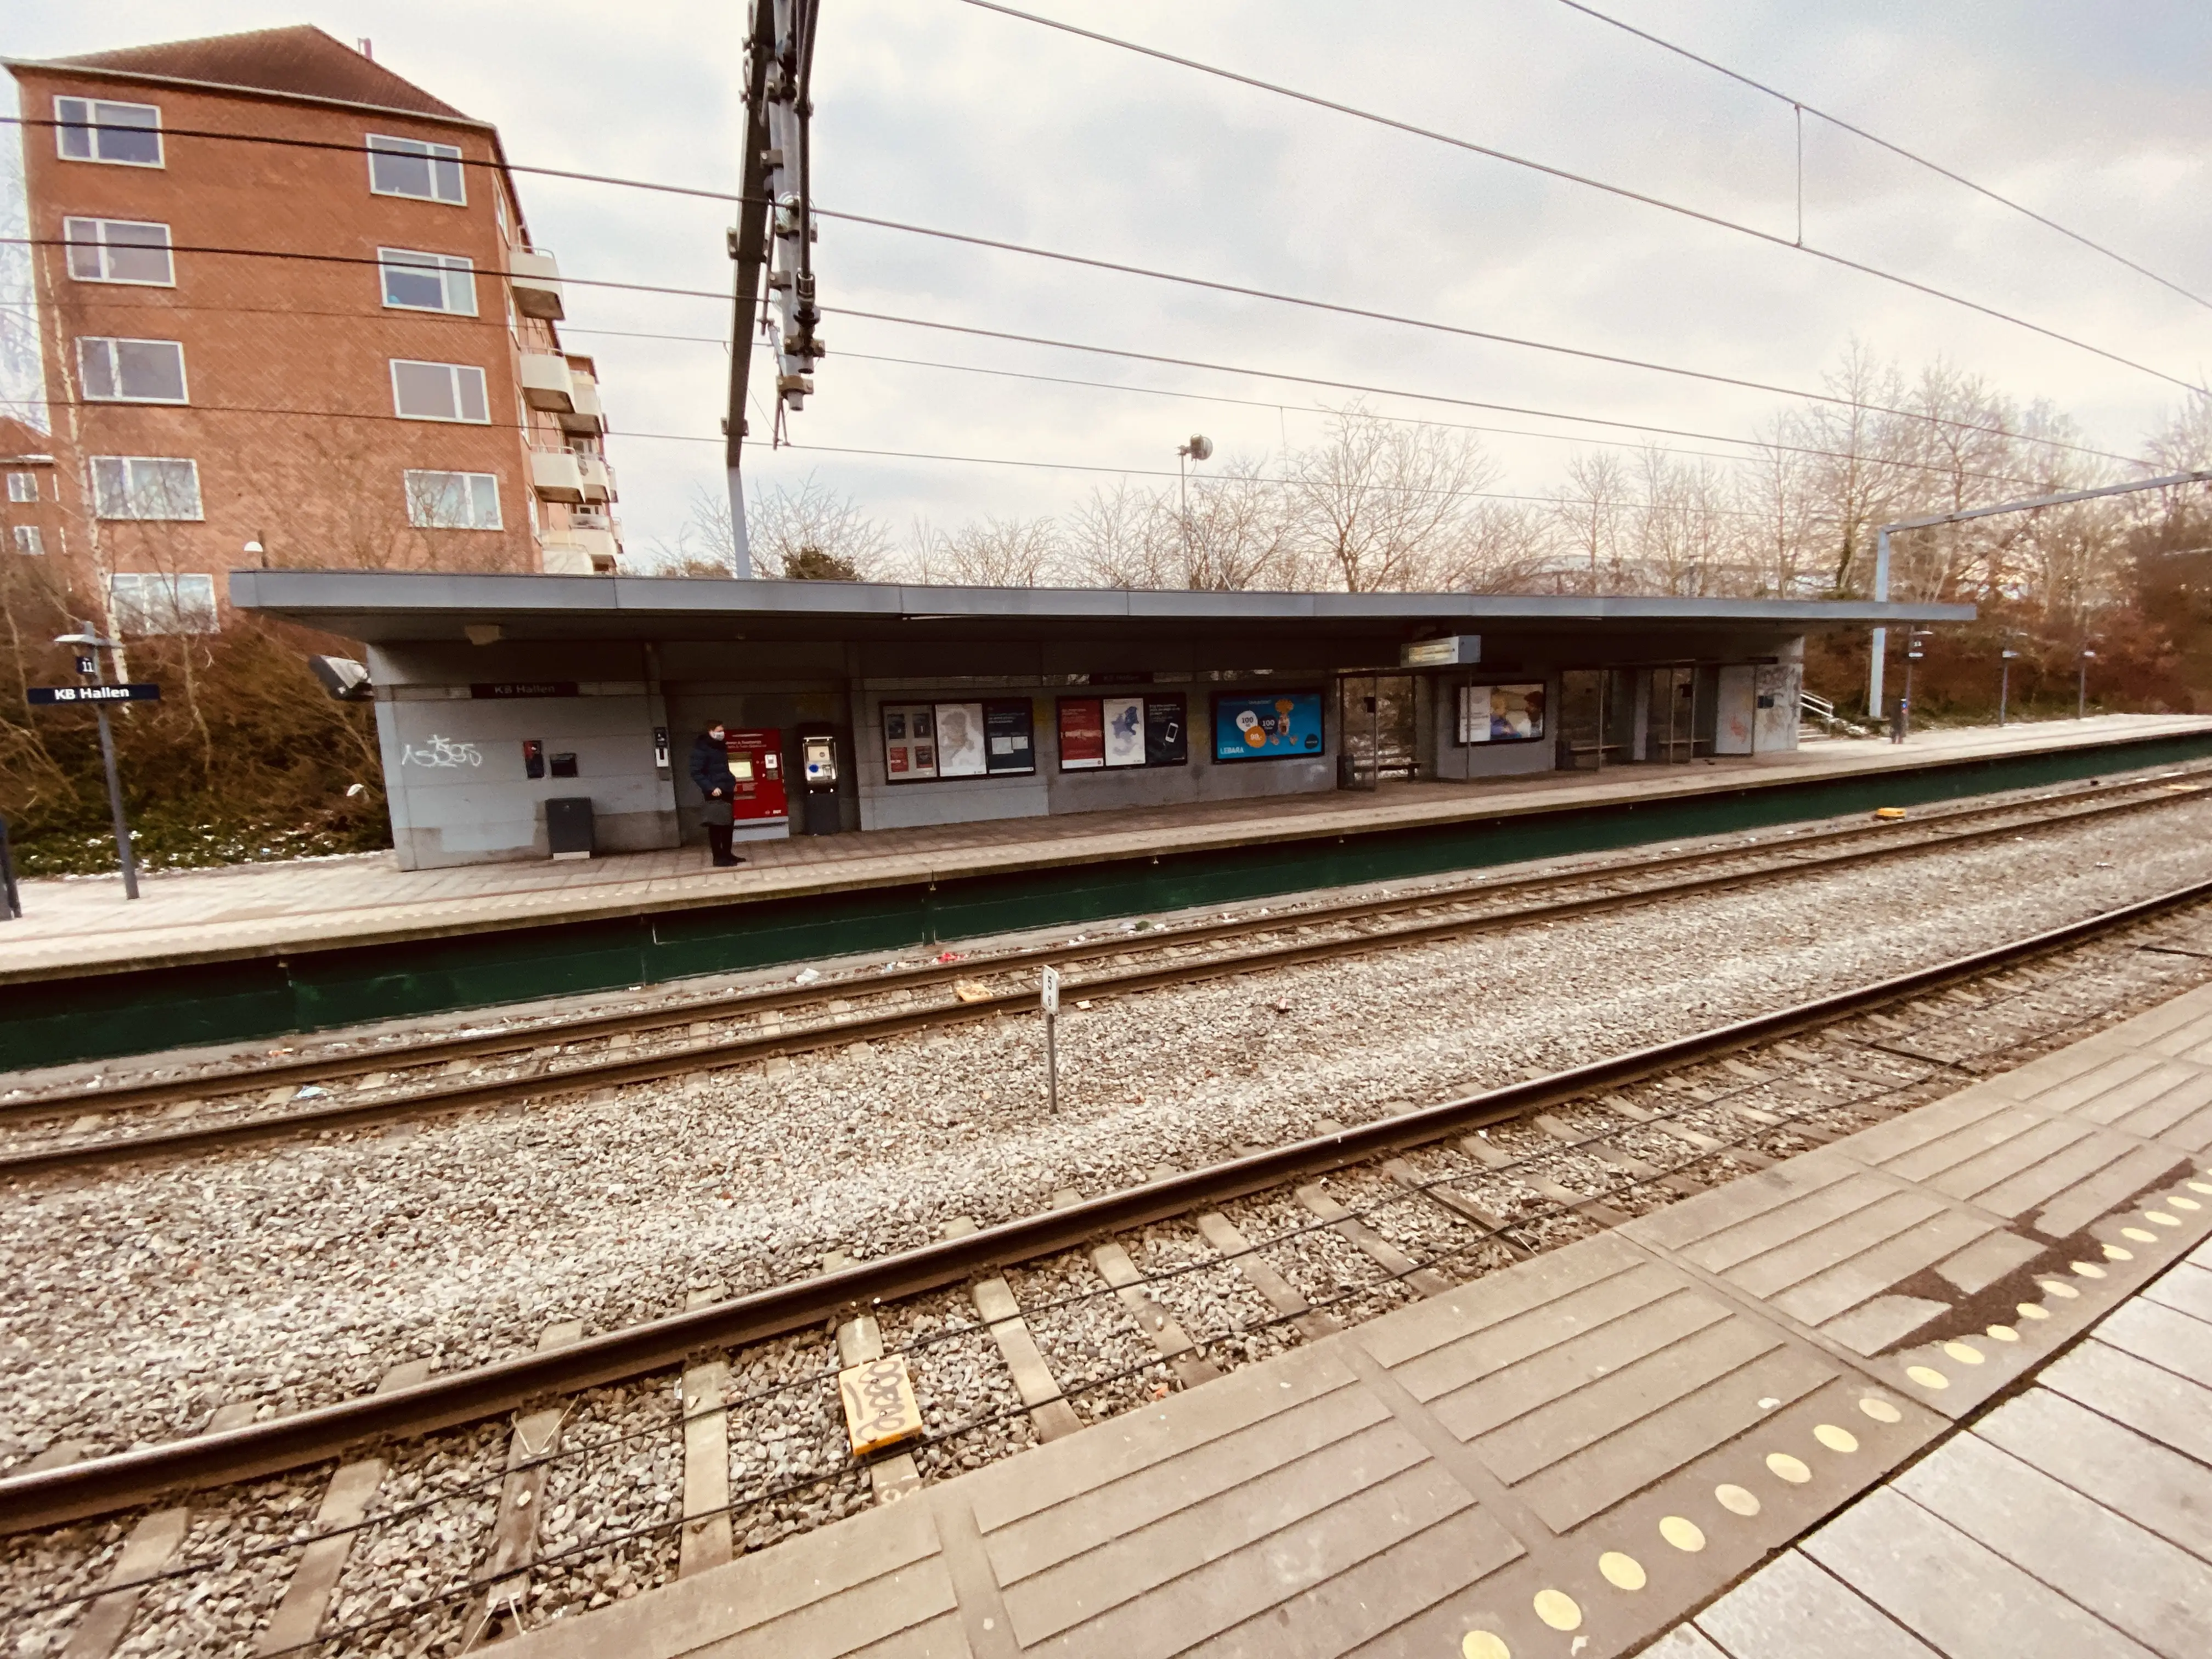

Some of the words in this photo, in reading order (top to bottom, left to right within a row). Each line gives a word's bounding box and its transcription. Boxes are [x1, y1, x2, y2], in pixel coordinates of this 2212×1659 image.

[54, 689, 76, 700] KB
[80, 687, 129, 699] Hallen
[1048, 975, 1052, 990] 5
[1048, 995, 1052, 1006] 6
